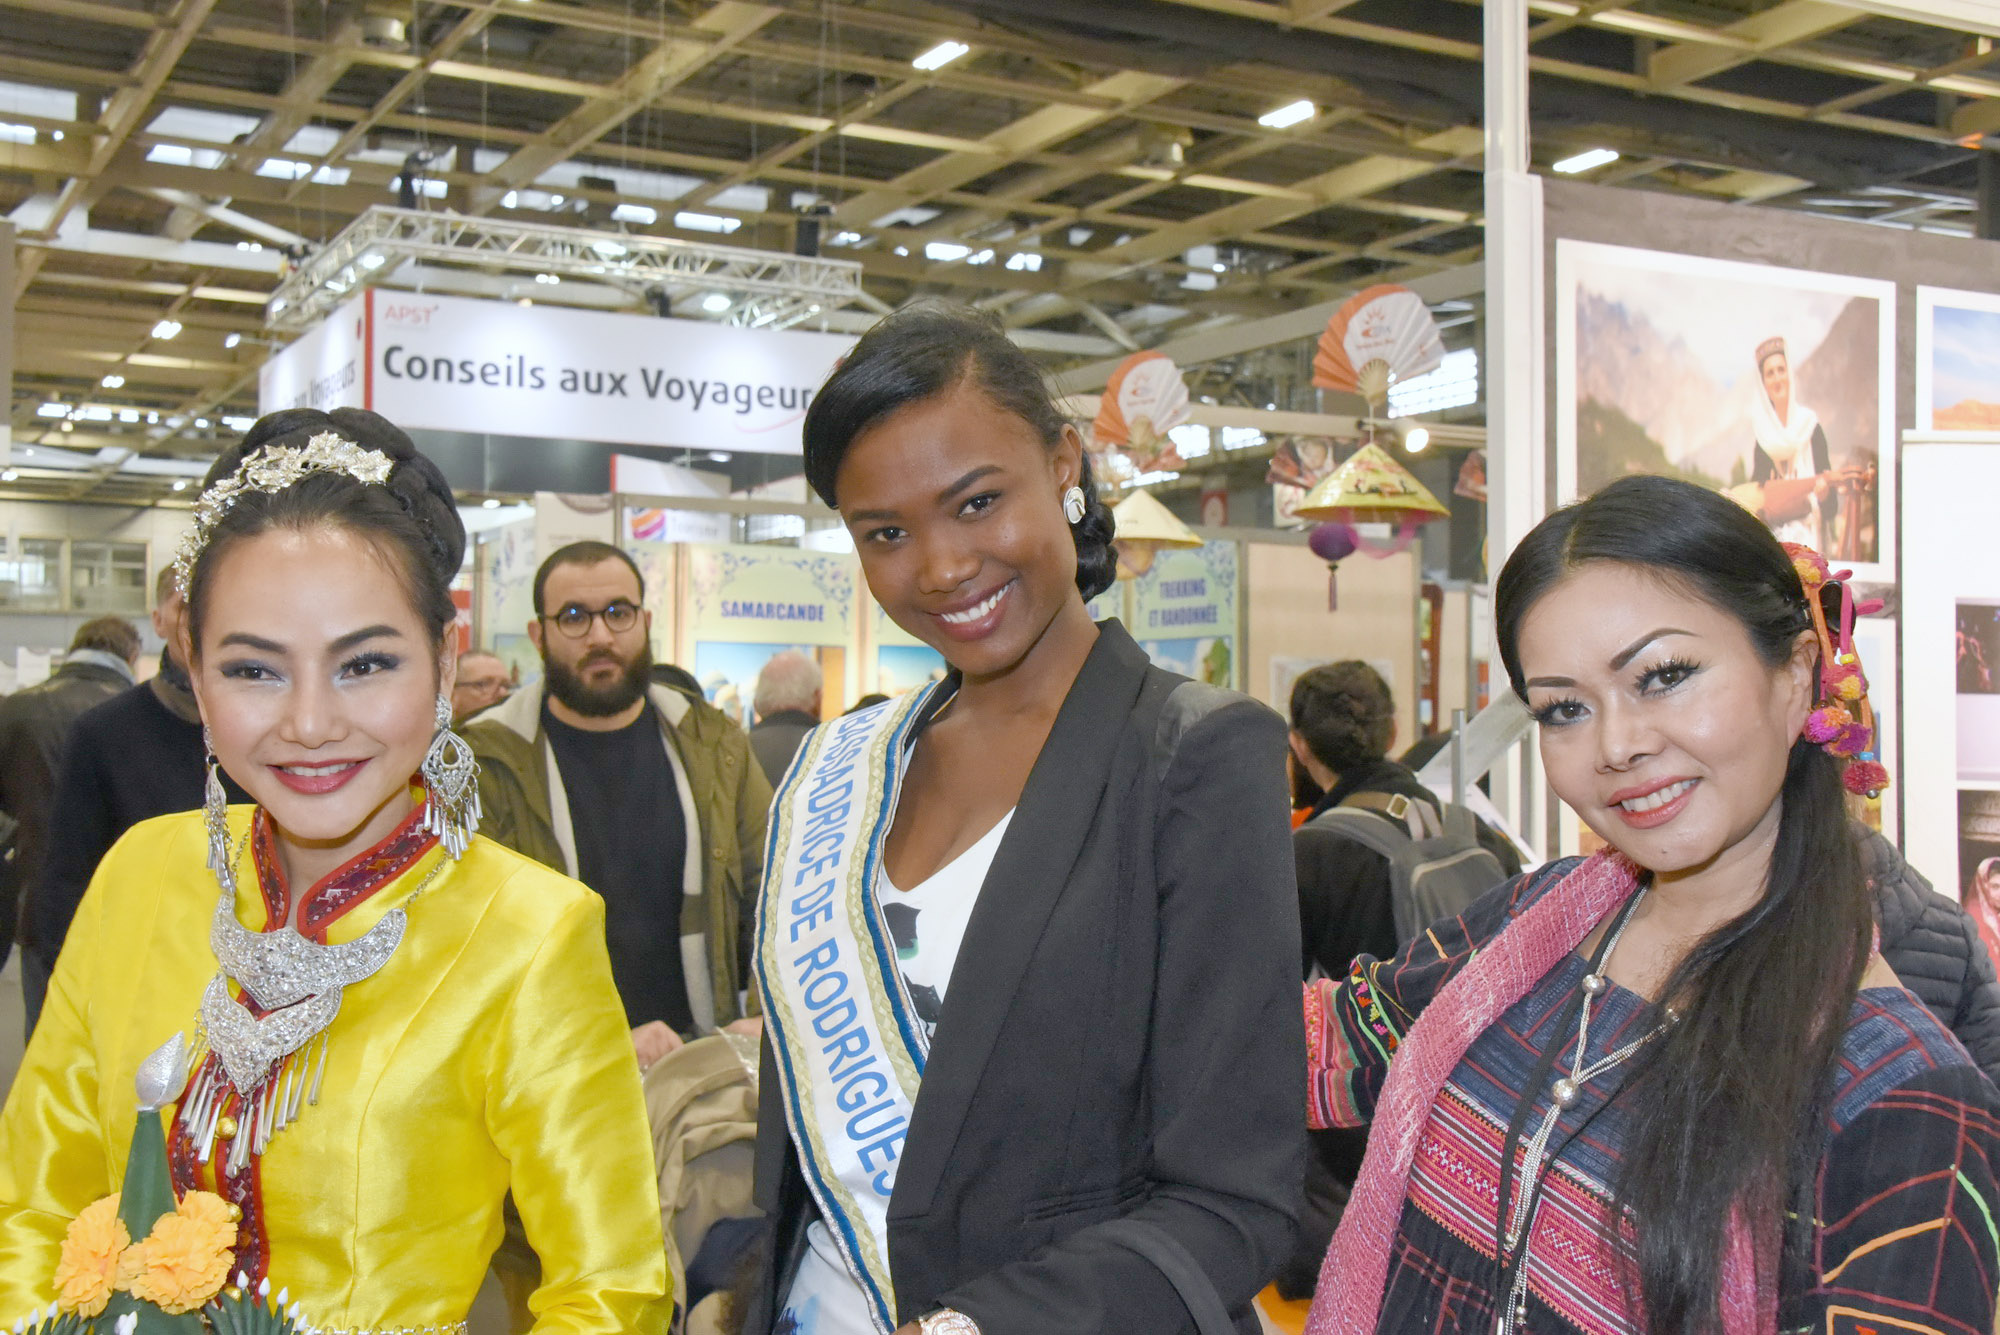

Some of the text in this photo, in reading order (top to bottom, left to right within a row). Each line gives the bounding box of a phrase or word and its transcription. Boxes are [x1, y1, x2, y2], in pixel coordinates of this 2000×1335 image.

[385, 305, 432, 324] APST
[383, 345, 813, 415] Conseils aux Voyageur
[1159, 577, 1207, 600] TREKKING
[720, 600, 825, 622] SAMARCANDE
[1148, 609, 1159, 628] ET
[789, 877, 836, 943] DE
